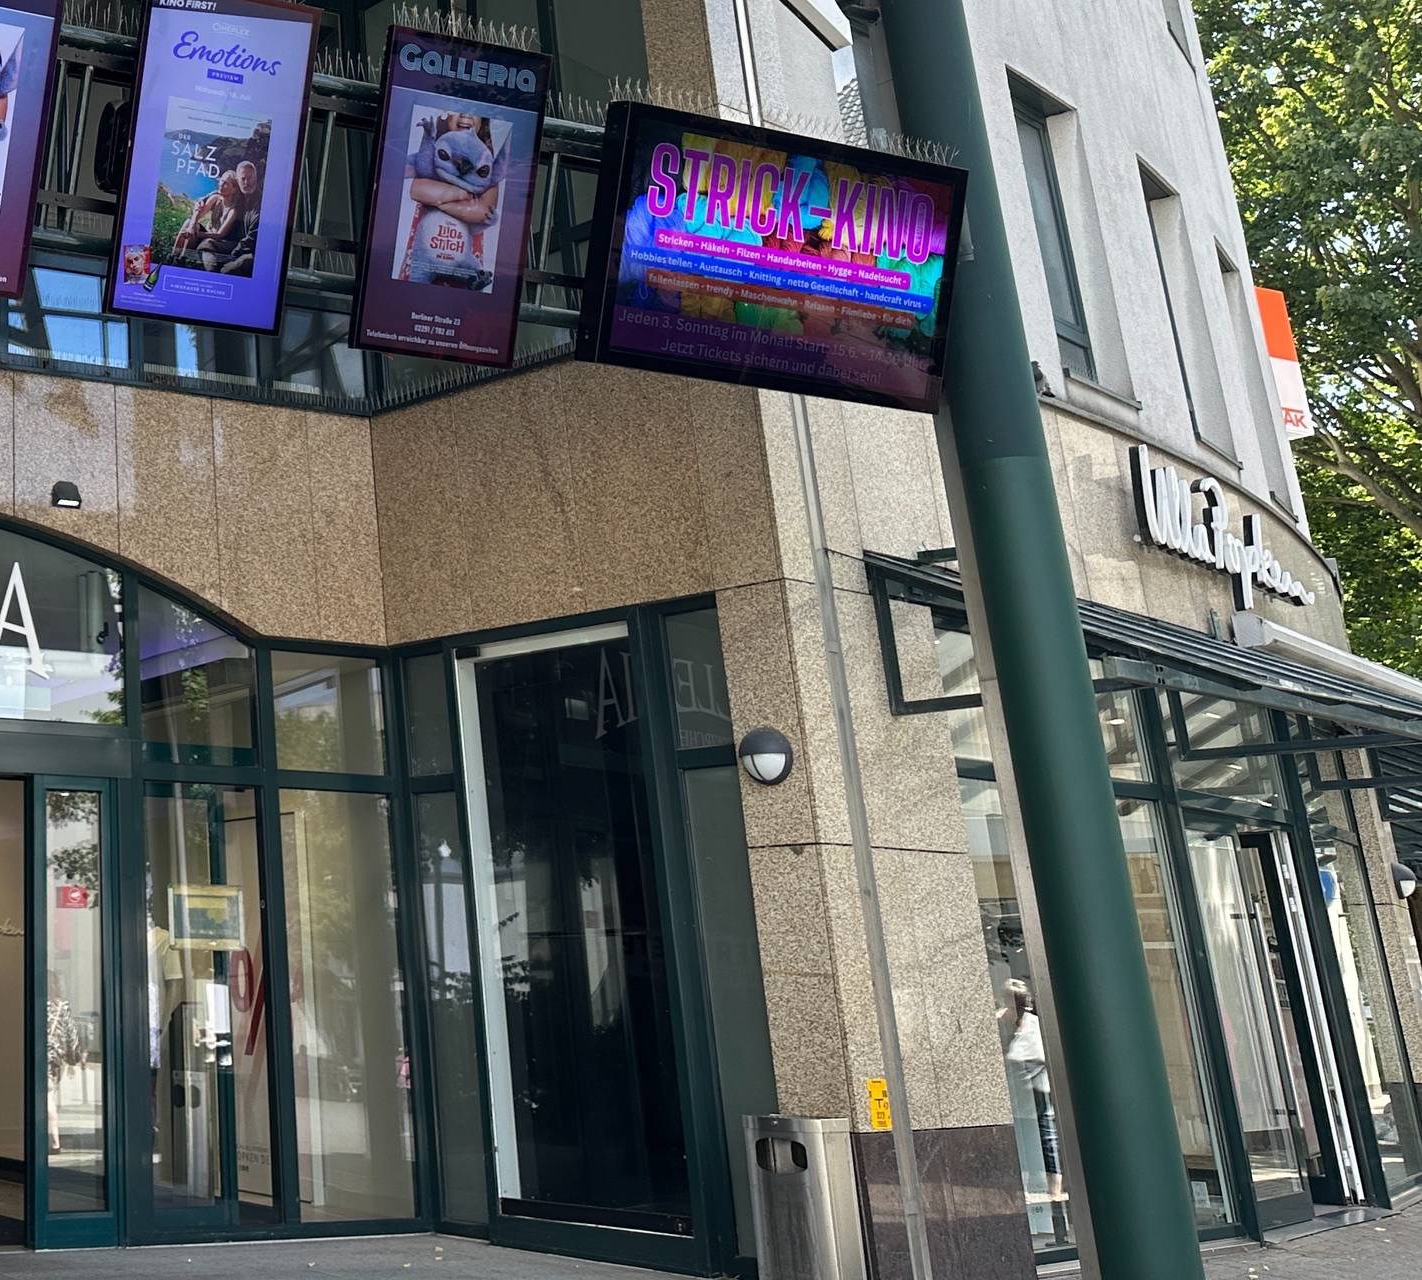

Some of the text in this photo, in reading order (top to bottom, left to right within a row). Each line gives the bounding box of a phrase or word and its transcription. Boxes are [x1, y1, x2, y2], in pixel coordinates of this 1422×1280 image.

[185, 0, 217, 11] FIRST!
[173, 30, 282, 76] Emotions
[171, 141, 218, 162] SALZ
[176, 159, 220, 179] PFAD
[647, 142, 935, 265] STRICK-KINO
[631, 250, 922, 308] Hobbies teilen Austausch Knitting nette Gesellschaft handcraft virus
[658, 233, 901, 285] Stricken Häkeln Filzen Handarbeiten Hygge Nadelsucht
[649, 273, 912, 326] fallenlassen trendy Maschenwahn Relaxen Filmliebe für dich
[618, 309, 659, 328] Jeden
[662, 316, 673, 330] 3.
[676, 318, 728, 341] Sonntag
[732, 326, 746, 342] im
[750, 330, 793, 349] Monat!
[661, 339, 694, 355] Jetzt
[698, 343, 741, 363] Tickets
[744, 352, 789, 370] sichern
[792, 360, 815, 375] und
[818, 361, 851, 379] dabei
[1281, 407, 1308, 429] AK
